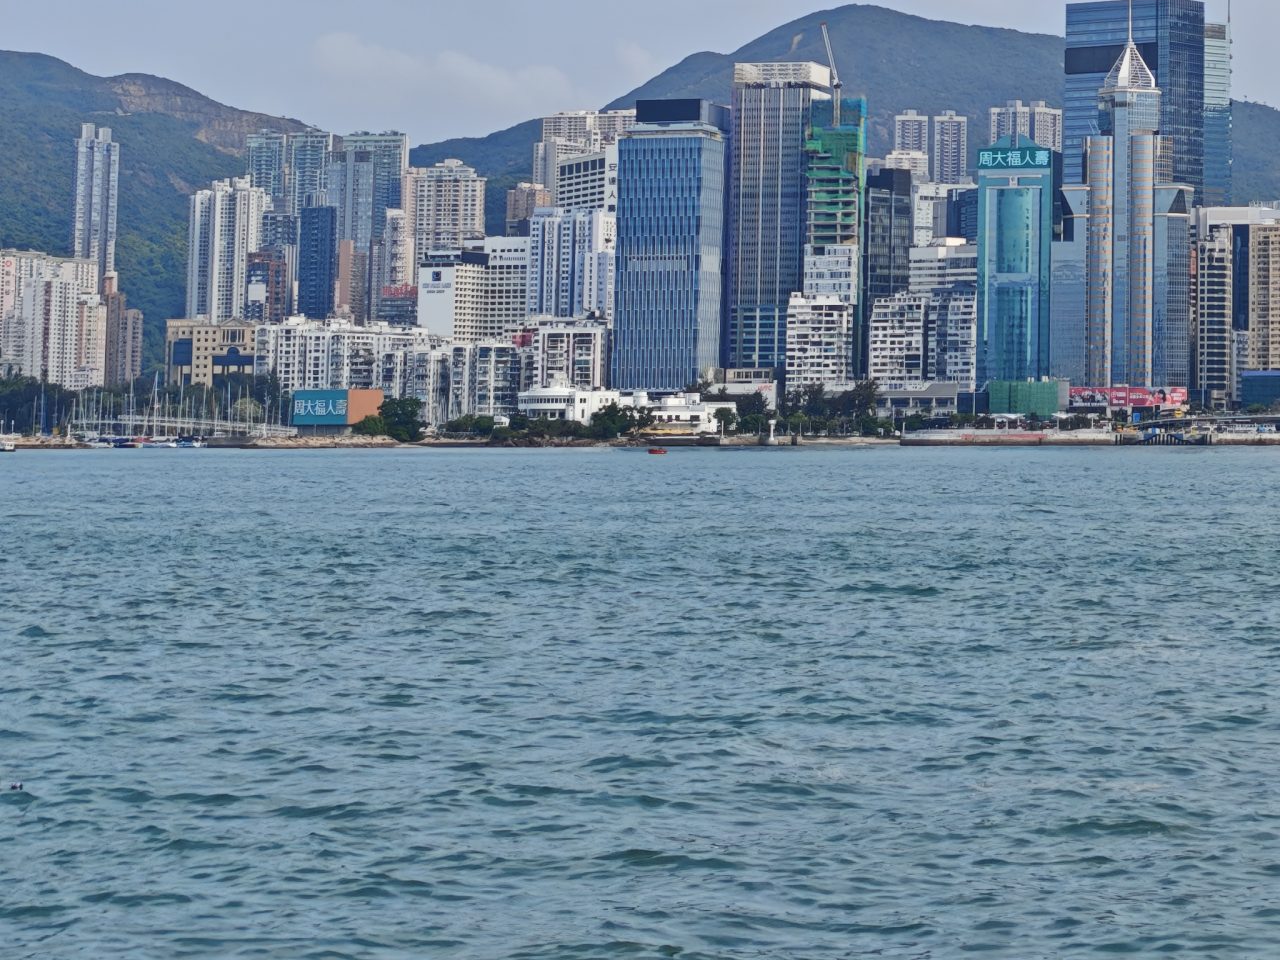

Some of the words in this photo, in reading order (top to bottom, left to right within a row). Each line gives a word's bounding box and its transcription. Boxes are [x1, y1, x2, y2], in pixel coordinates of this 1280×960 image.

[978, 150, 1050, 167] 周大福人壽
[293, 399, 348, 416] 周大福人壽
